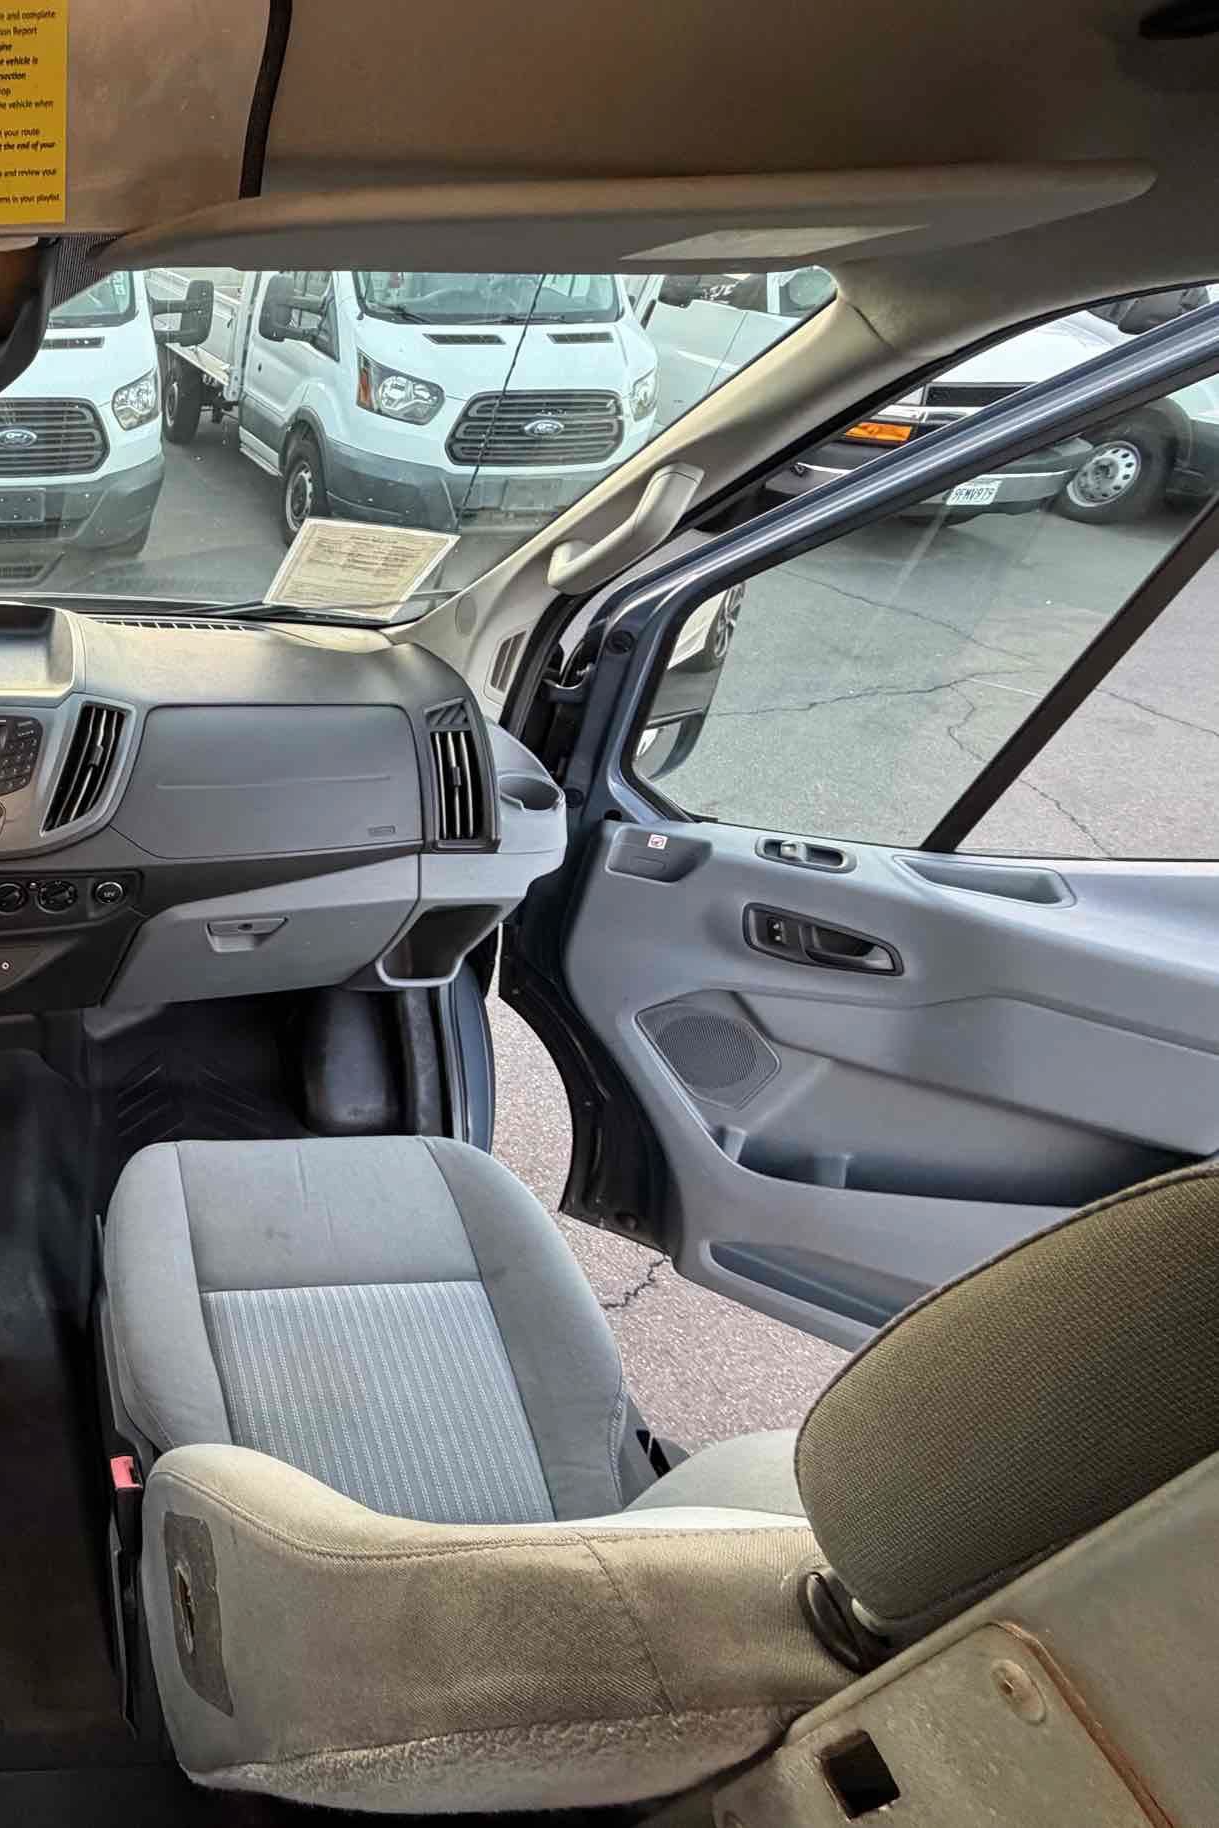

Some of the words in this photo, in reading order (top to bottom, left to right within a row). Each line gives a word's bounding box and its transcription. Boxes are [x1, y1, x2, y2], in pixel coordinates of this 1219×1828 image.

[7, 12, 20, 20] and
[22, 10, 55, 21] complete
[13, 27, 38, 37] Report
[6, 57, 30, 65] vehicle
[8, 100, 32, 108] vehicle
[4, 129, 19, 138] your
[21, 127, 40, 136] route
[3, 142, 15, 150] the
[16, 141, 30, 150] end
[39, 142, 56, 151] your
[4, 168, 17, 177] and
[18, 168, 41, 176] review
[42, 168, 56, 177] your
[20, 195, 36, 204] your
